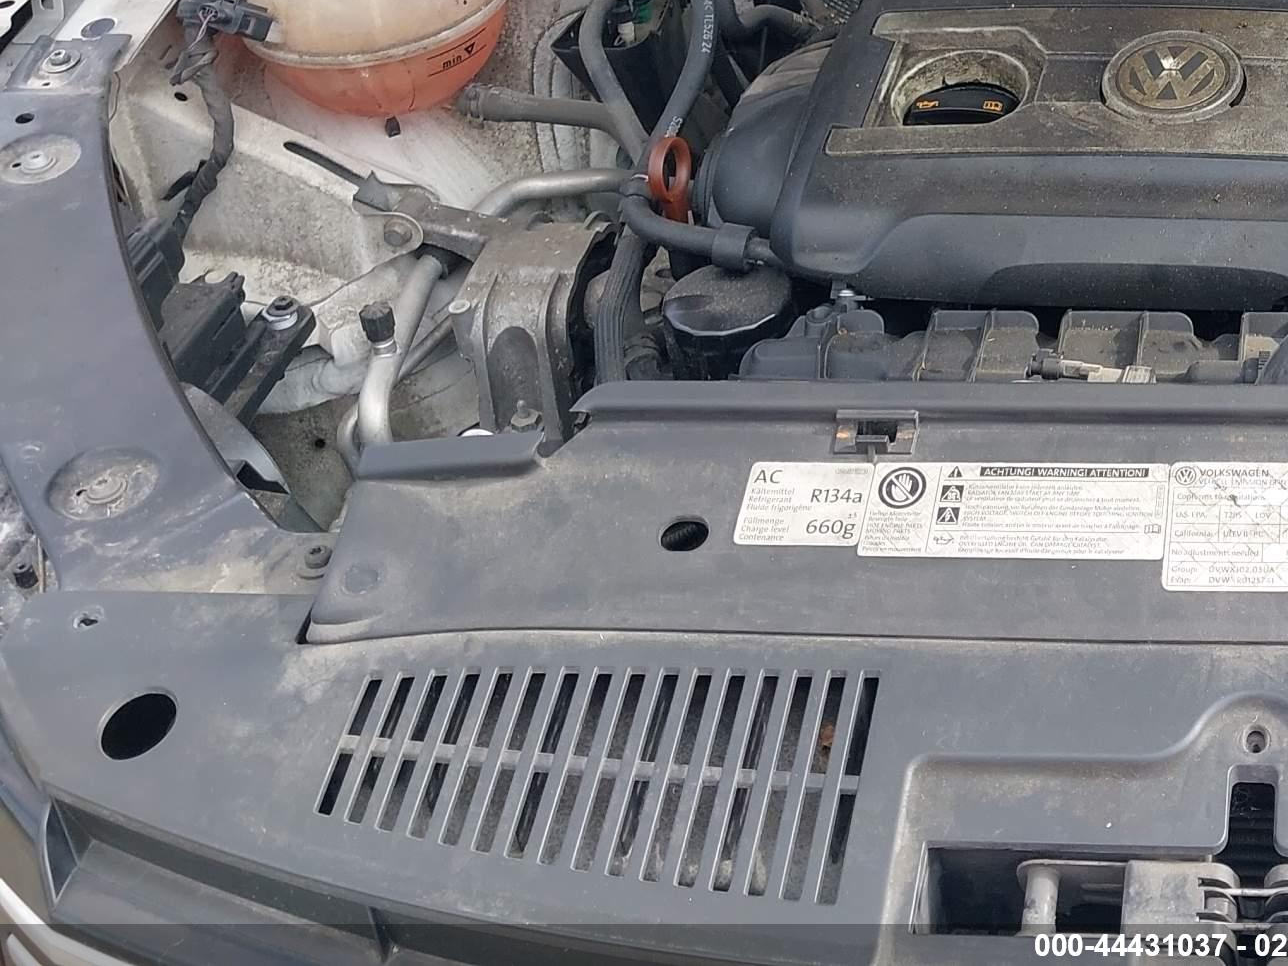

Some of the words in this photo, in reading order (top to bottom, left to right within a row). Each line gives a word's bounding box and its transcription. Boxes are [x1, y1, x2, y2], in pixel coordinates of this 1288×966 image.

[442, 54, 462, 71] min
[753, 469, 784, 485] AC
[983, 467, 1035, 477] ACHTUNG!
[1036, 467, 1088, 478] WARNING!
[1089, 468, 1147, 478] ATTENTION!
[1200, 468, 1270, 478] VOLKSWAGEN
[748, 495, 793, 505] Refrigerant
[810, 488, 863, 504] R134a
[741, 524, 770, 534] Charge
[770, 524, 790, 533] level
[805, 518, 857, 540] 660g
[738, 533, 785, 542] Contenance
